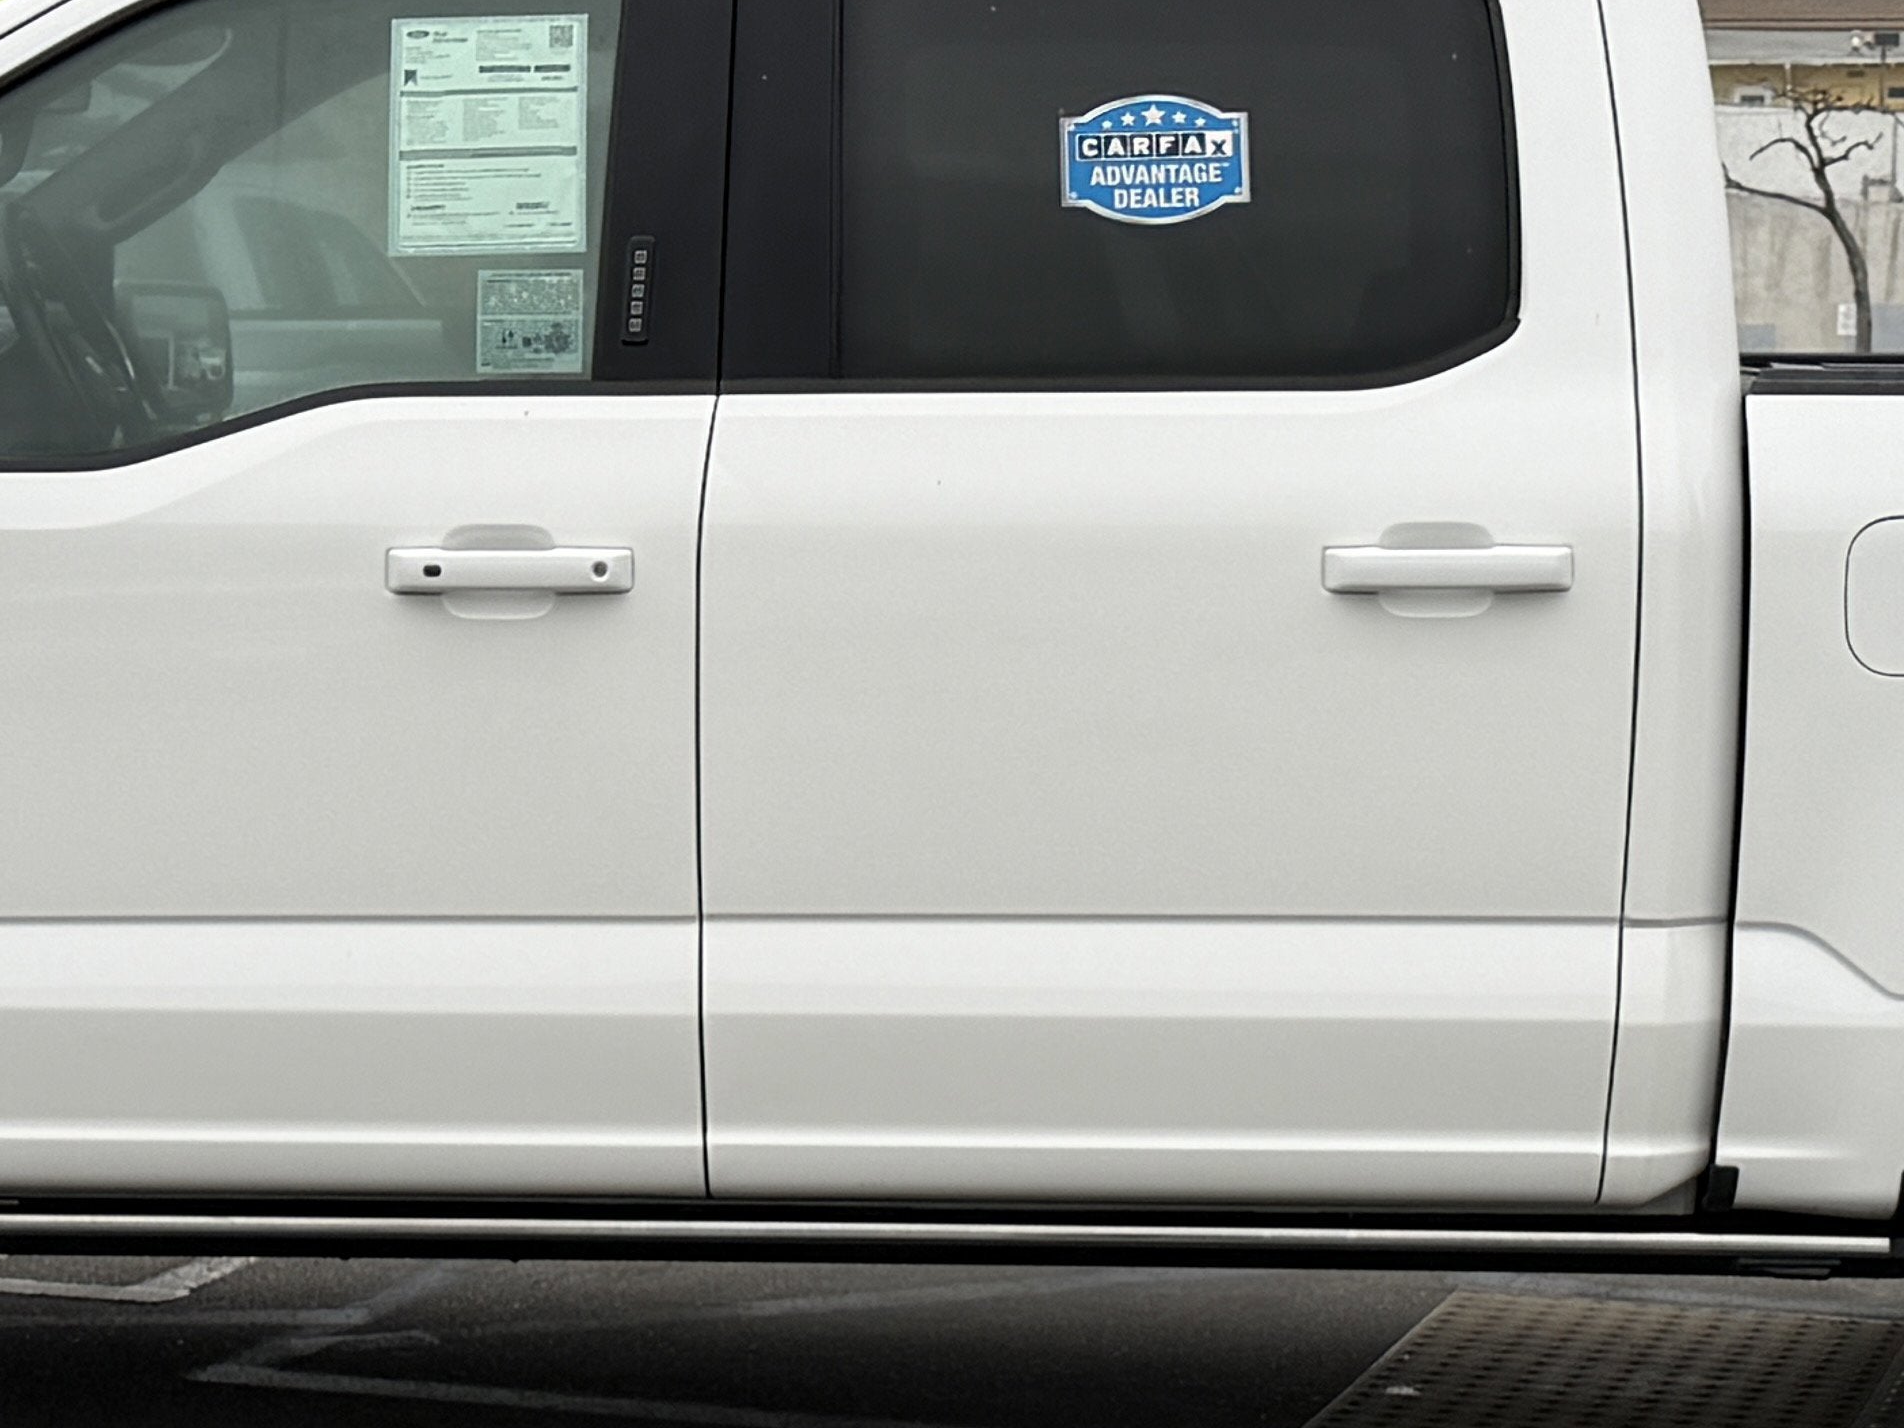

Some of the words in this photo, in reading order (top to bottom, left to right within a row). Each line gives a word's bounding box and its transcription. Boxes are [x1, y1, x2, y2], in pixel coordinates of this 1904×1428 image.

[1079, 133, 1229, 159] CARFAX
[1090, 163, 1223, 186] ADVANTAGE
[1114, 188, 1200, 209] DEALER
